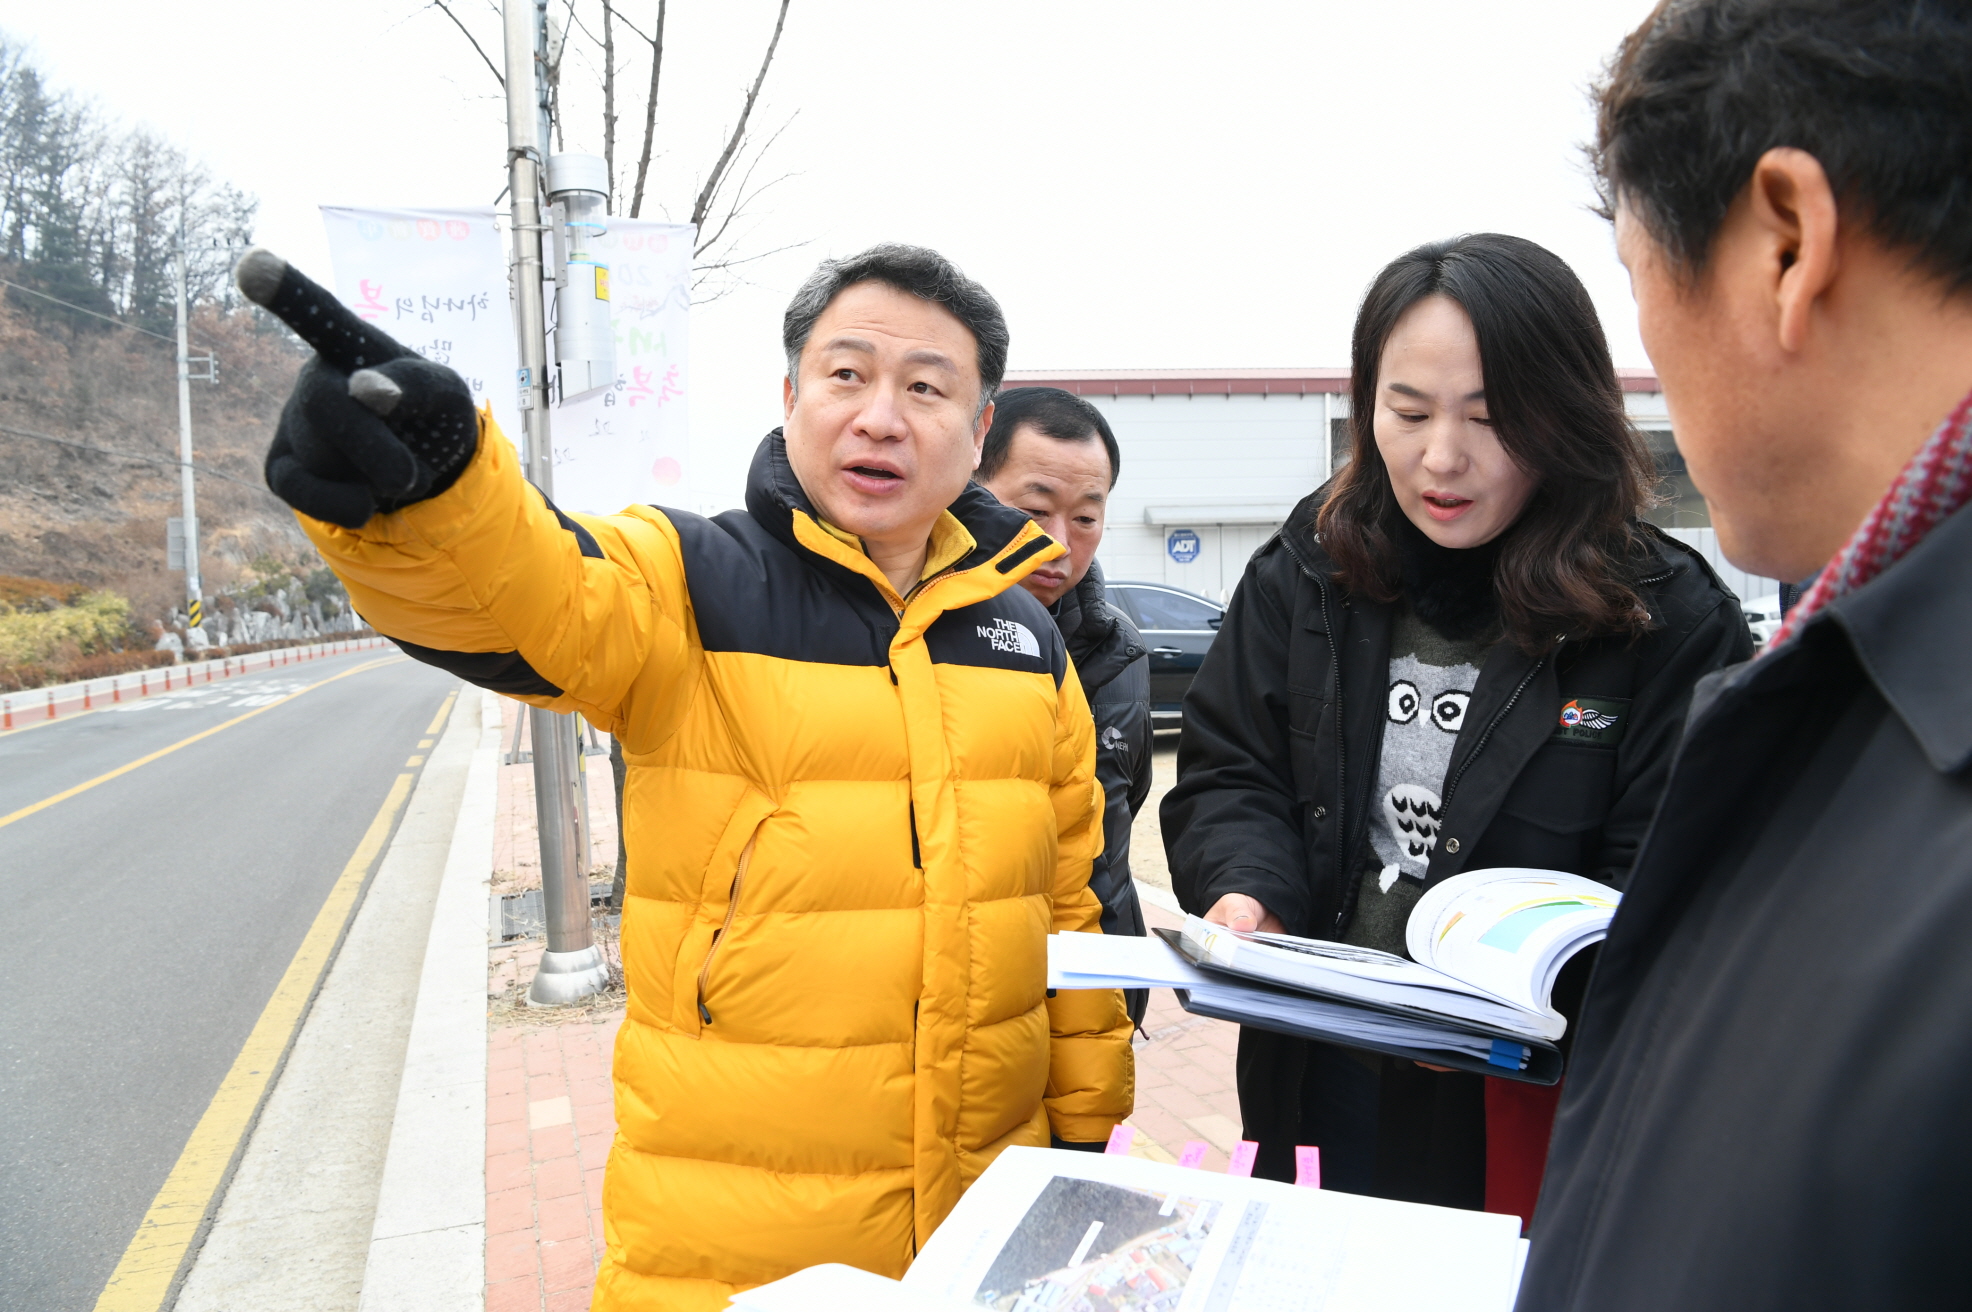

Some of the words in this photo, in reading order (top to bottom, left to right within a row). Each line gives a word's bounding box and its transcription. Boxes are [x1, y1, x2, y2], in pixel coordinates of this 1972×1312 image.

[1172, 539, 1196, 553] ADT
[993, 618, 1017, 632] THE
[976, 625, 1019, 643] NORTH
[991, 638, 1023, 654] FACE
[1573, 728, 1603, 739] POLICE
